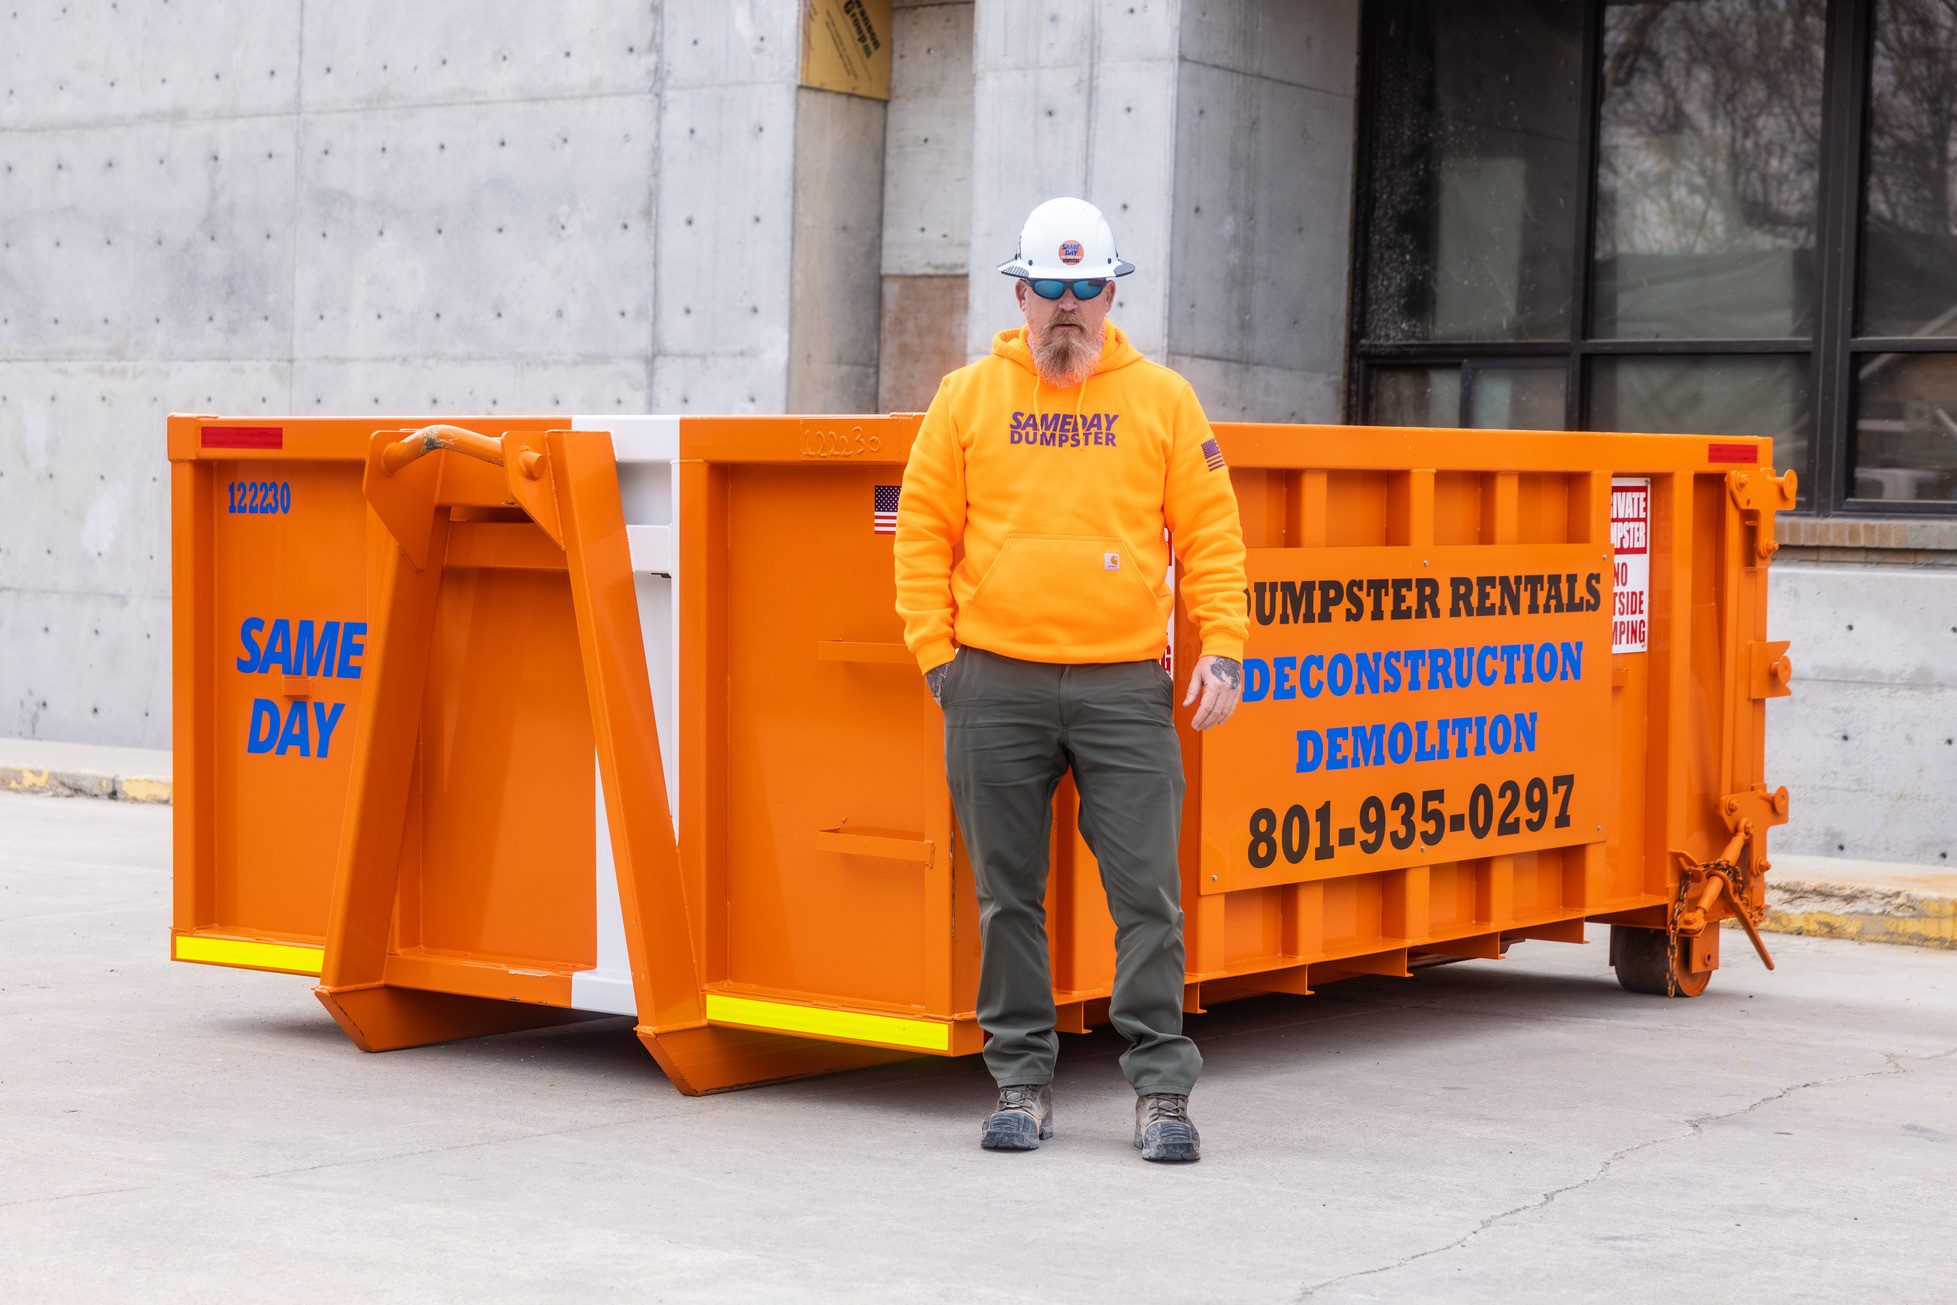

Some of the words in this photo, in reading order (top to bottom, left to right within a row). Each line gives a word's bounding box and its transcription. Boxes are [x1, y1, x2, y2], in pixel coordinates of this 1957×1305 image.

[1010, 430, 1117, 448] DUMPSTER
[228, 481, 291, 515] 122230
[1611, 491, 1647, 519] IVATE
[1243, 579, 1441, 626] UMPSTER
[1449, 572, 1601, 618] RENTALS
[1613, 561, 1629, 587] NO
[236, 616, 368, 679] SAME
[1242, 641, 1584, 703] DECONSTRUCTION
[247, 698, 346, 759] DAY
[1295, 711, 1539, 774] DEMOLITION
[1247, 773, 1576, 869] 801-935-0297
